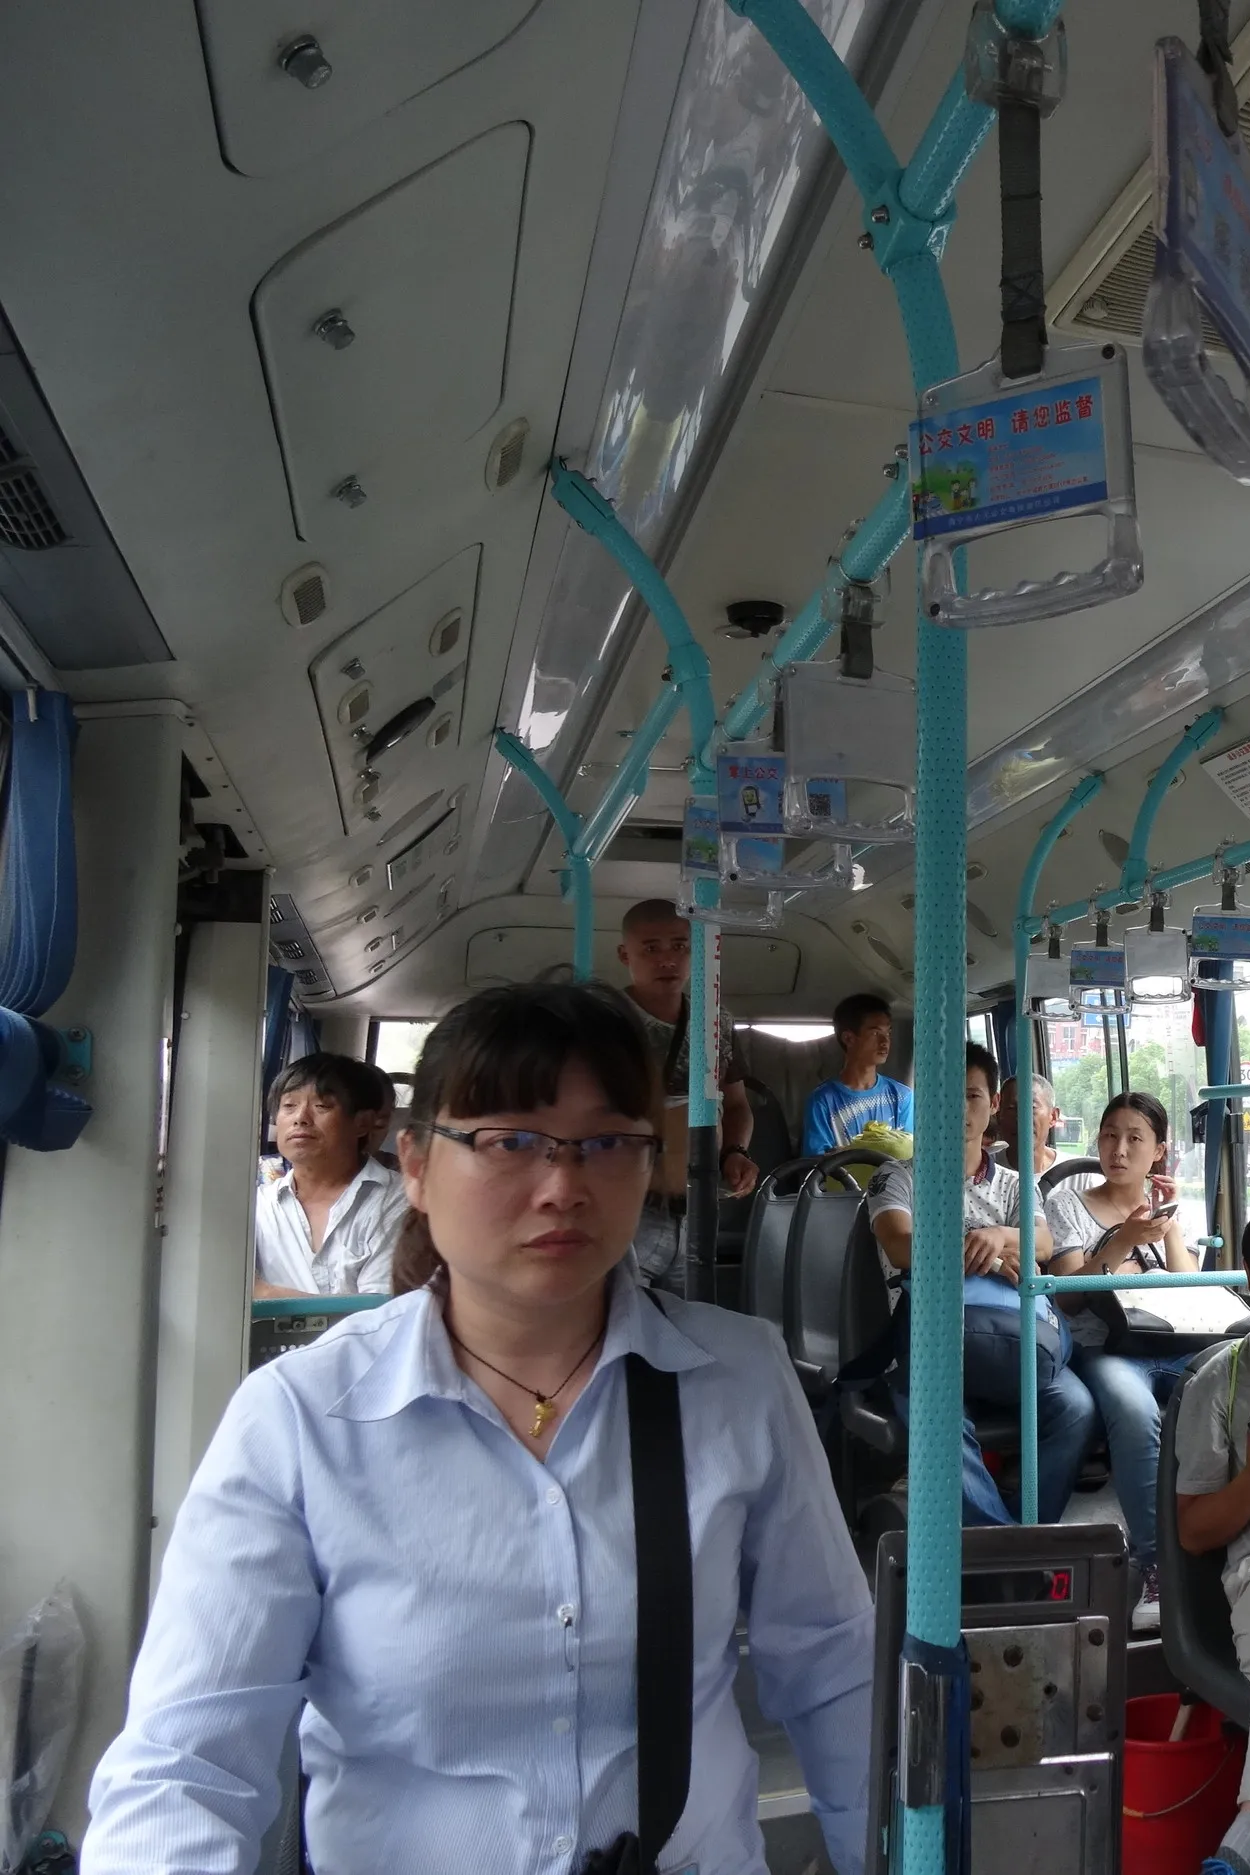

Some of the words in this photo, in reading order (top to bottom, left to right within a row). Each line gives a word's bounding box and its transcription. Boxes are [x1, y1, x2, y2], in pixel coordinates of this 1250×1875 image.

[918, 418, 995, 455] 公交文明
[1011, 395, 1094, 435] 请您监督
[728, 765, 779, 780] 掌上公交
[1050, 1572, 1069, 1600] 0
